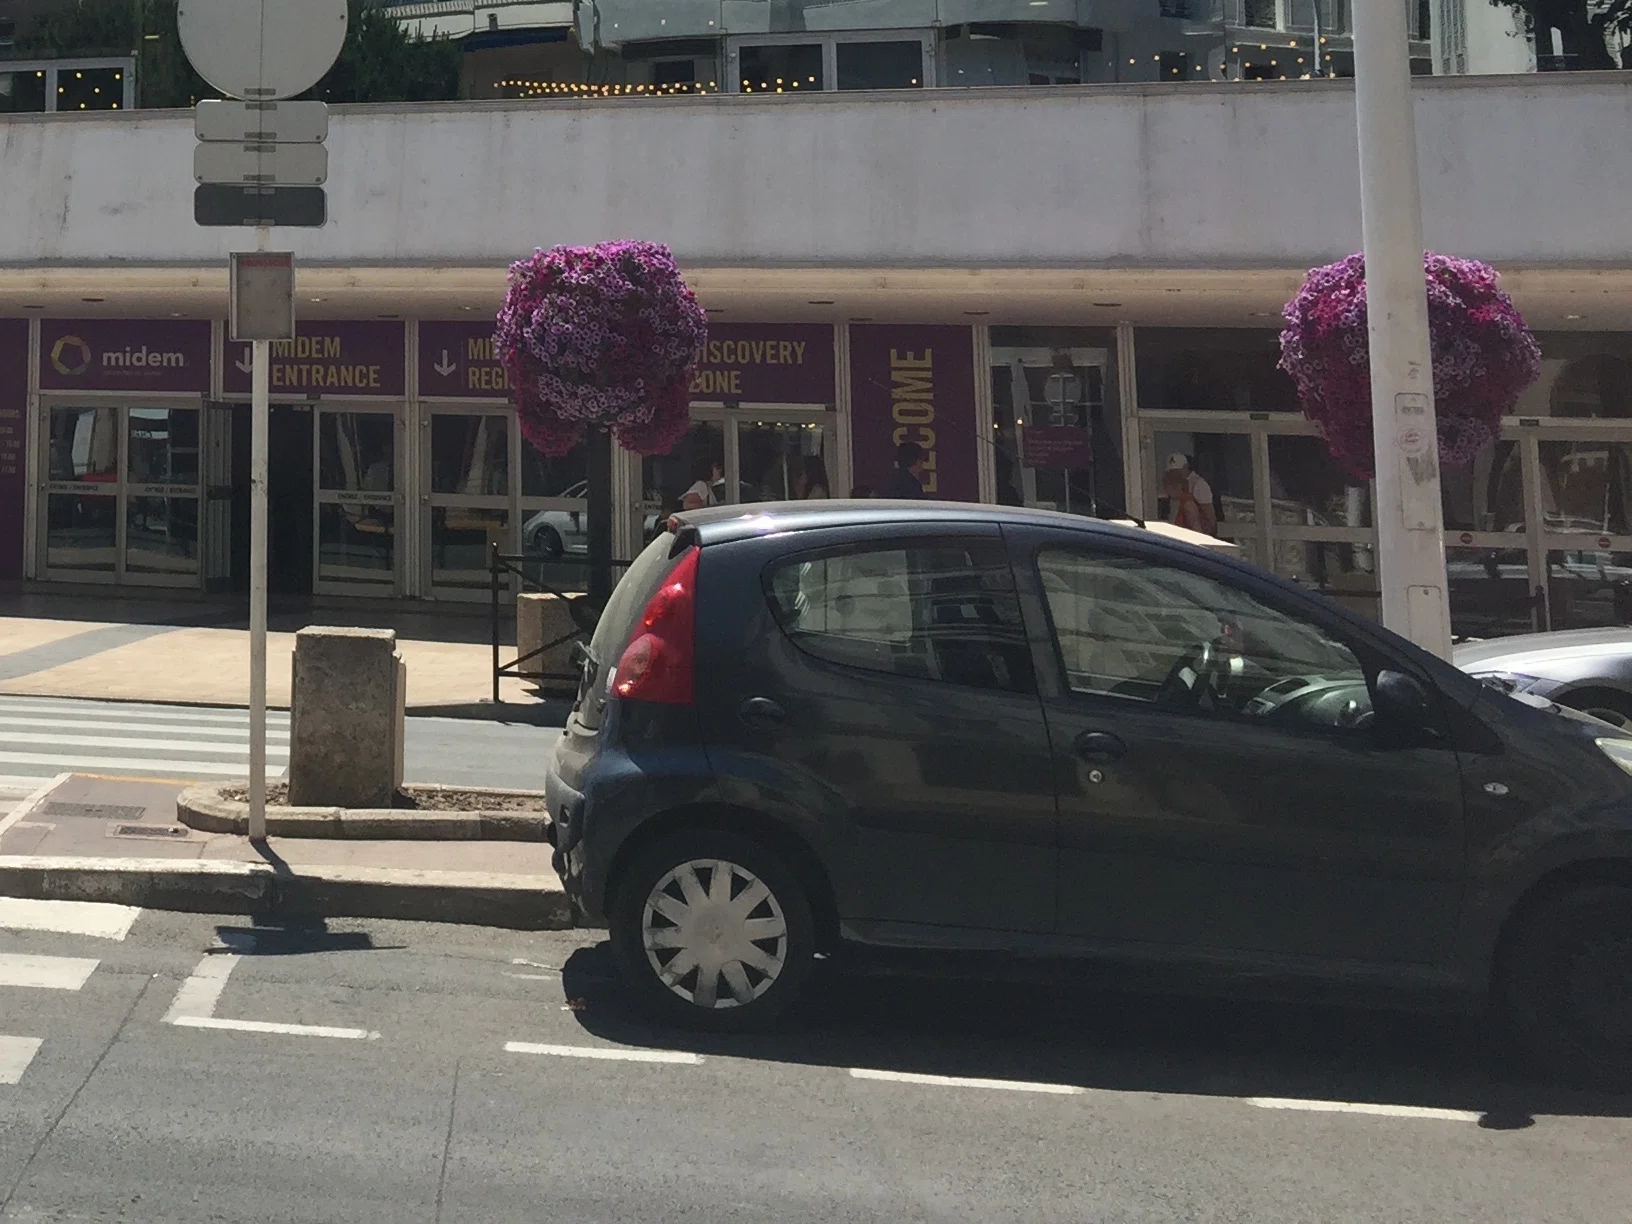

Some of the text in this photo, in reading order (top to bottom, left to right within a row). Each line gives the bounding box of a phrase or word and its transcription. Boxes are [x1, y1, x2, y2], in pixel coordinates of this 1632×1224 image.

[102, 345, 184, 367] midem
[272, 336, 341, 358] MIDEM
[272, 364, 381, 387] ENTRANCE
[688, 370, 743, 394] ZONE
